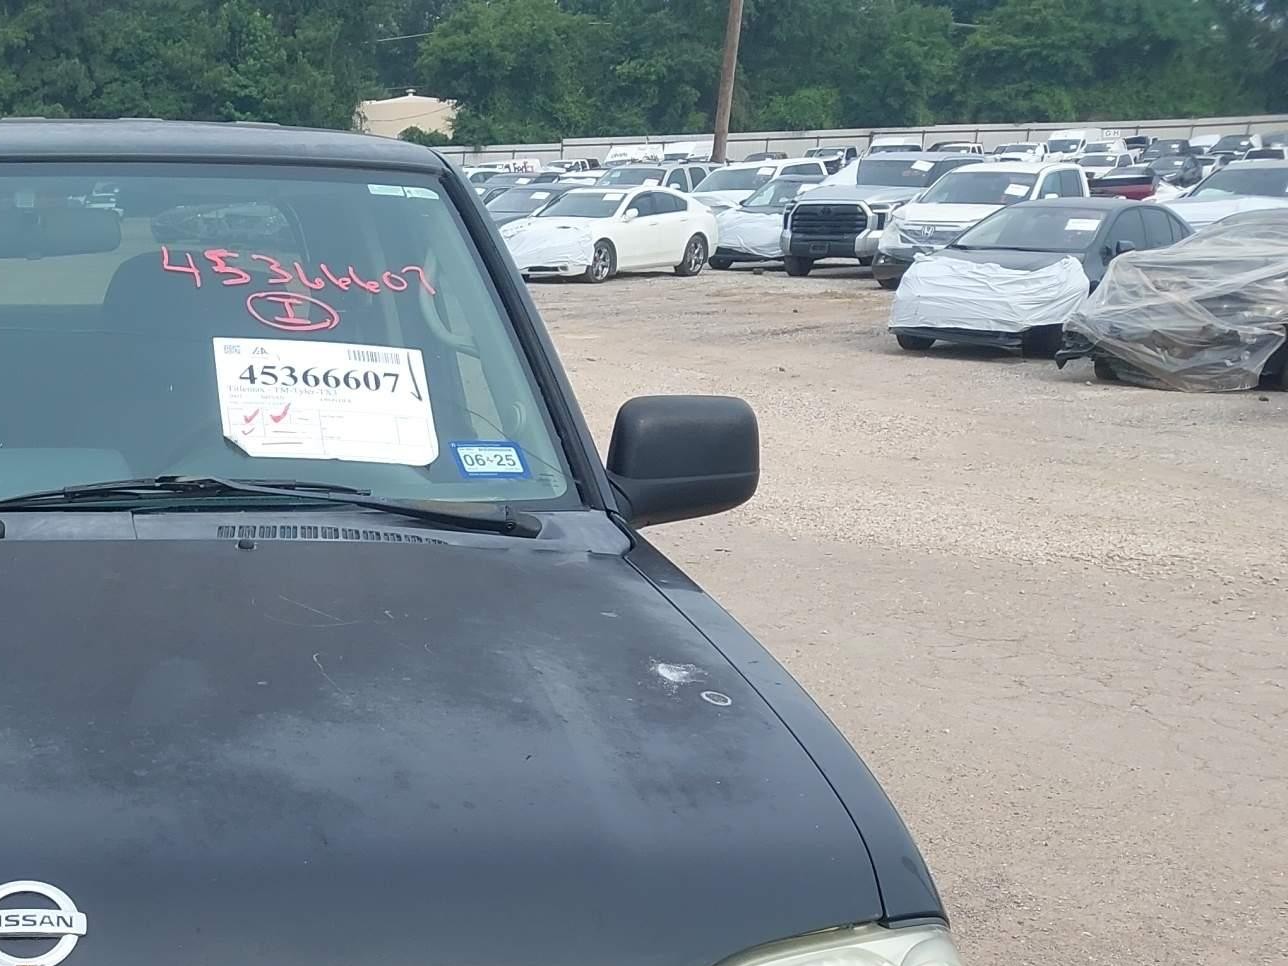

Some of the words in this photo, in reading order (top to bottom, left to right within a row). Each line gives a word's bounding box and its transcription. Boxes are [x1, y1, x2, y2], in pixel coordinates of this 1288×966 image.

[161, 245, 436, 296] 45366607
[239, 364, 400, 393] 45366607
[463, 454, 486, 467] 06
[493, 454, 516, 467] 25
